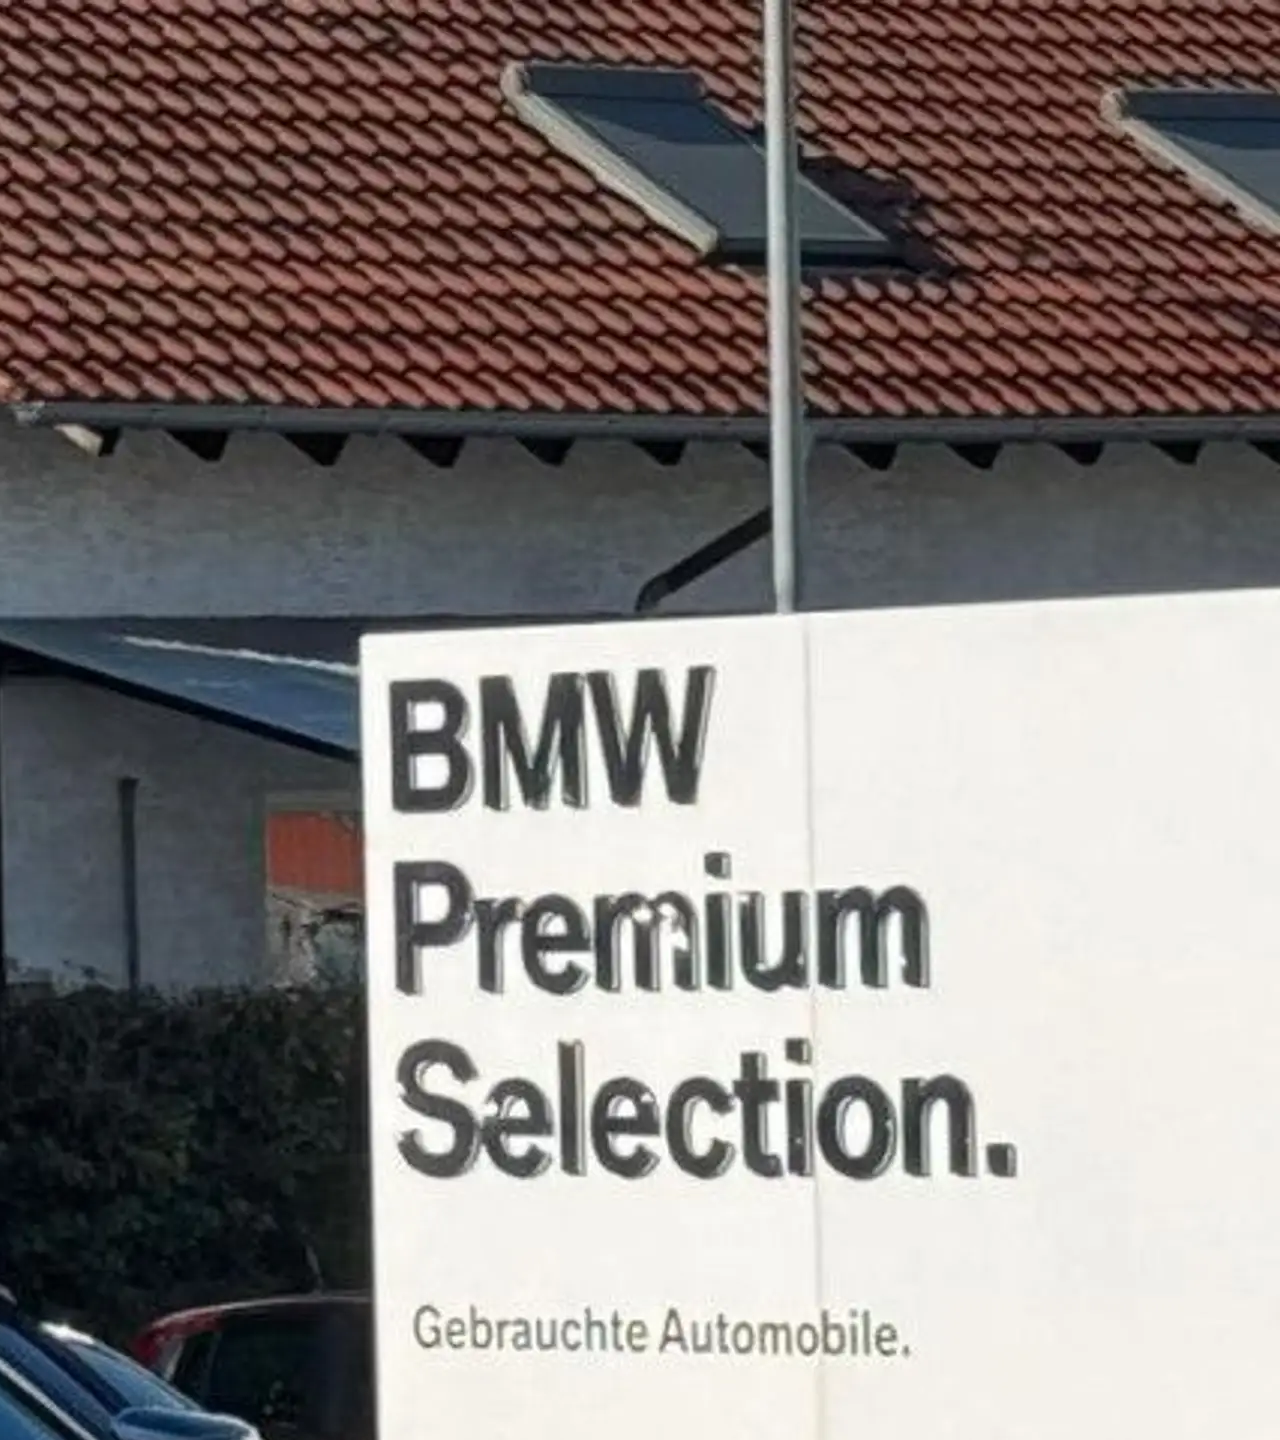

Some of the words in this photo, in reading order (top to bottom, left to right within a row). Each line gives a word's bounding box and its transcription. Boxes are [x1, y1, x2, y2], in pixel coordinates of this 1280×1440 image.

[388, 665, 716, 814] BMW
[392, 851, 931, 996] Premium
[395, 1036, 1017, 1181] Selection.
[412, 1304, 649, 1353] Gebrauchte
[658, 1307, 911, 1357] Automobile.
